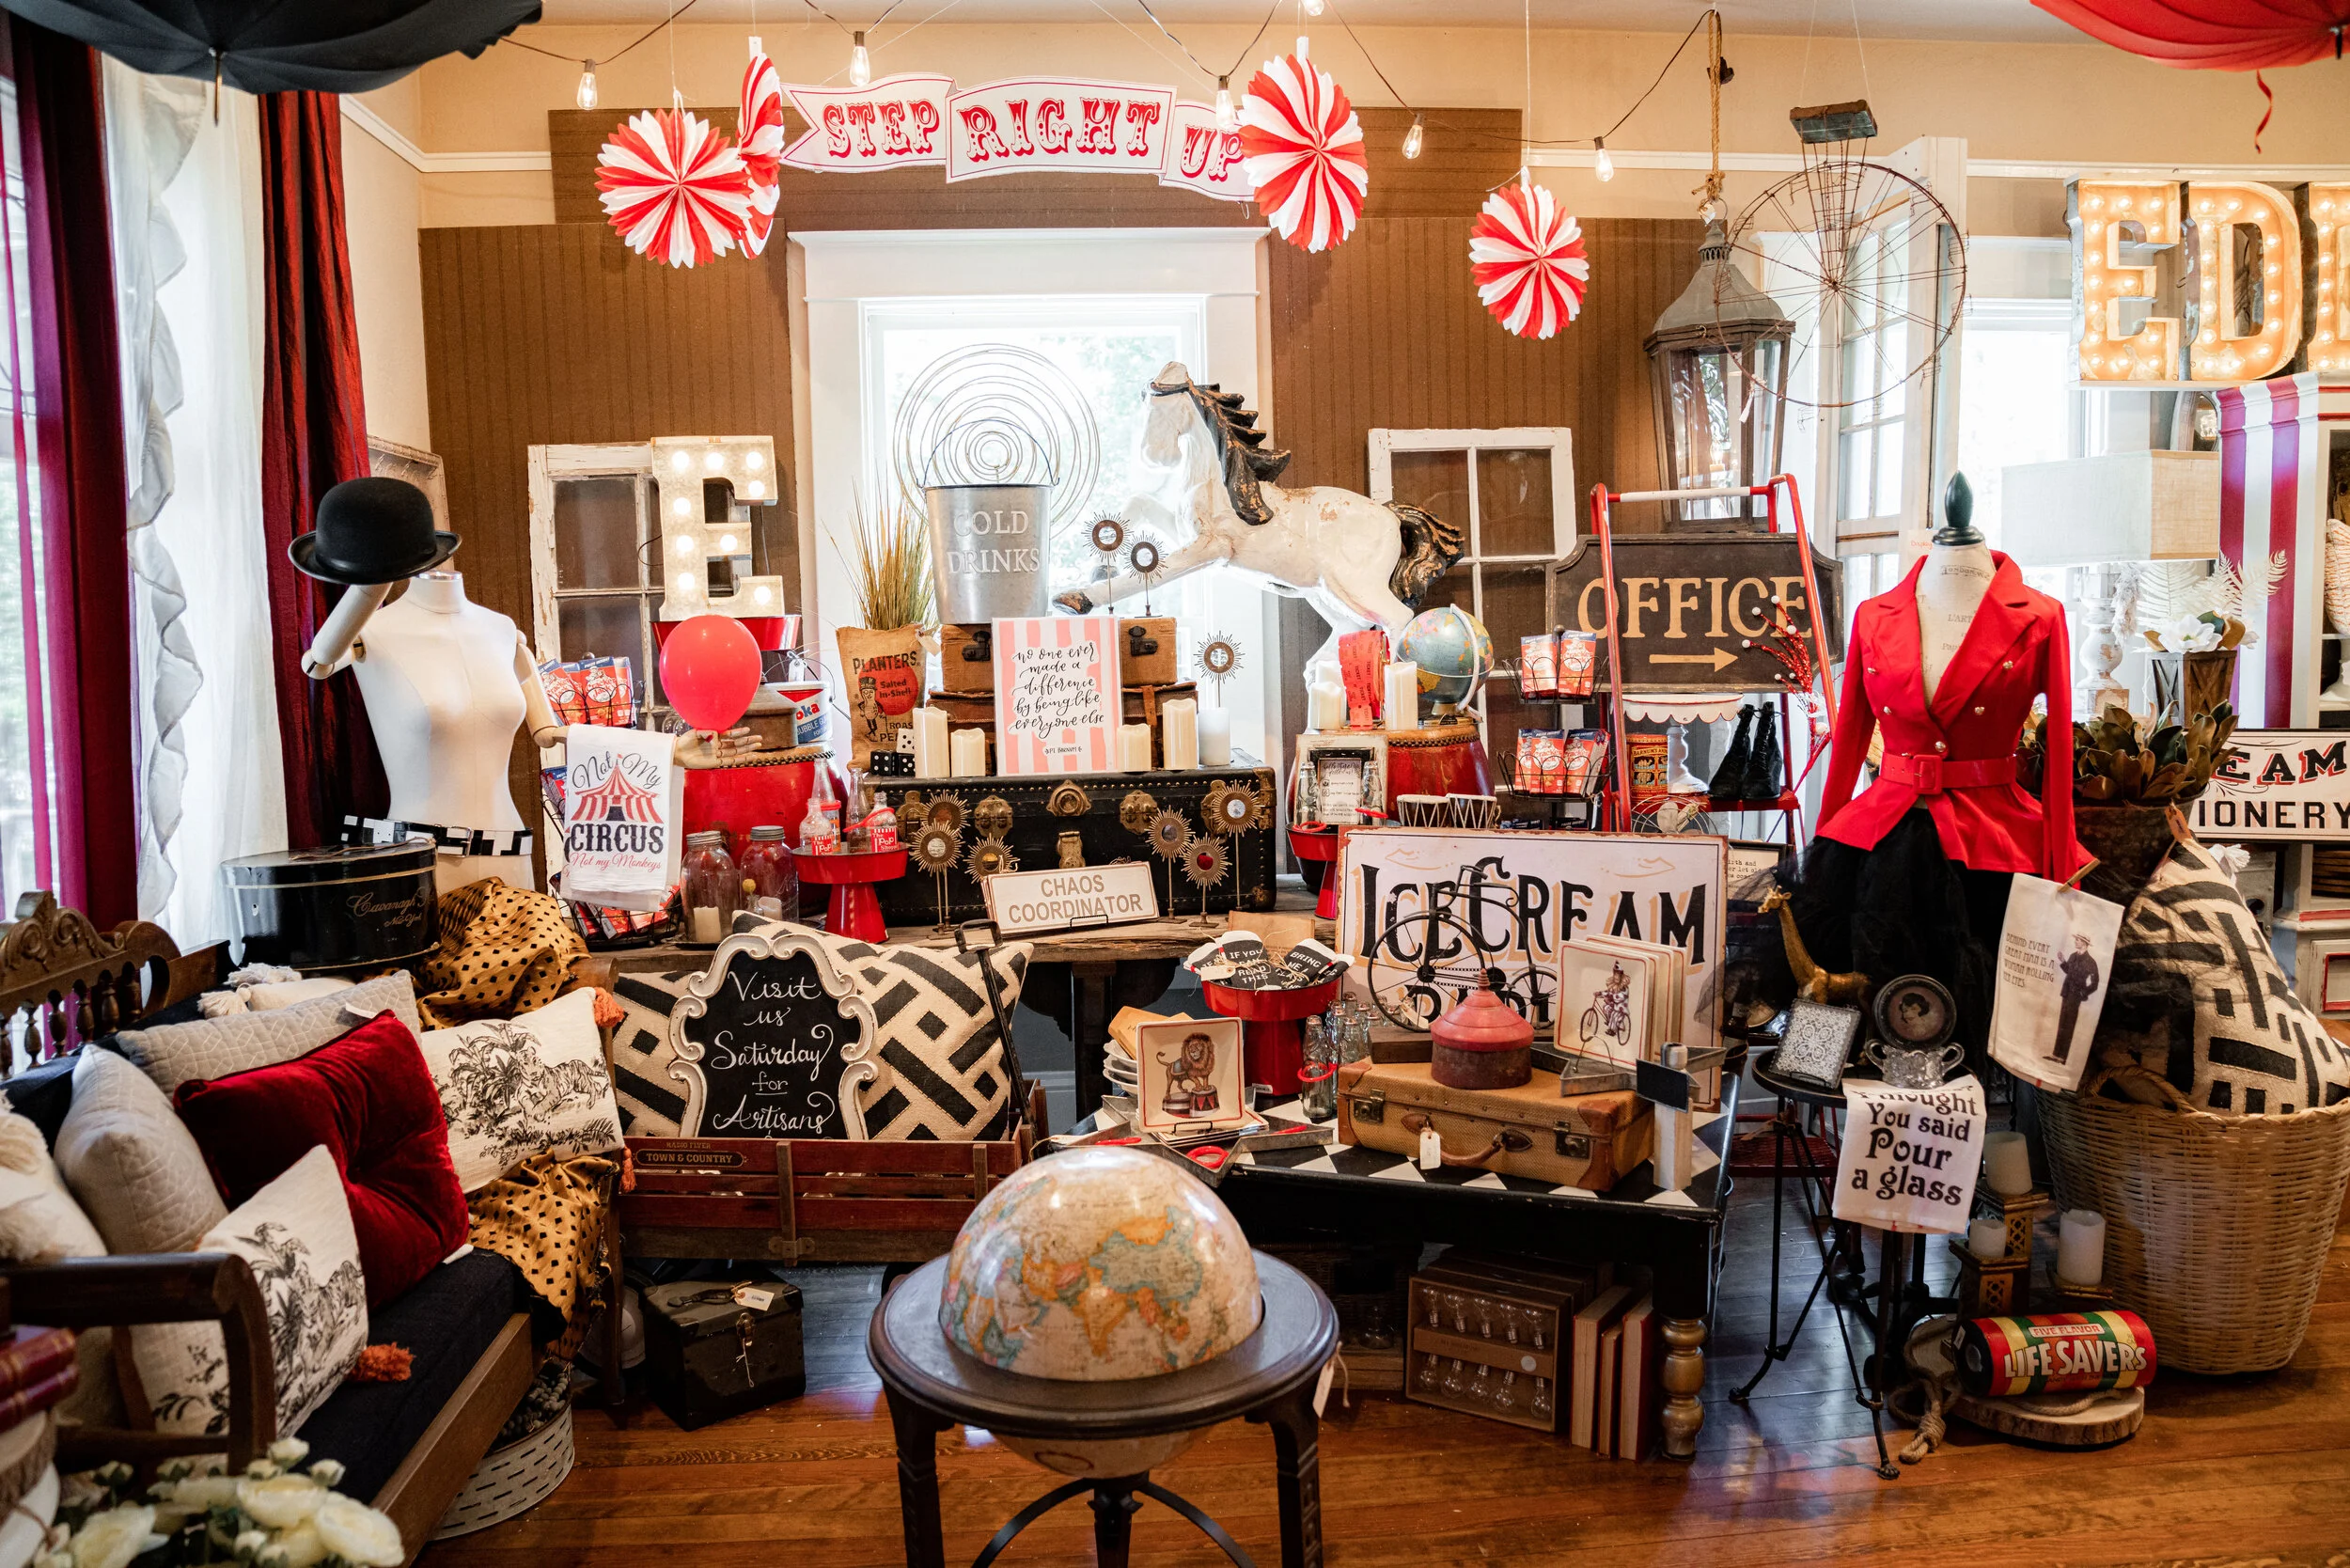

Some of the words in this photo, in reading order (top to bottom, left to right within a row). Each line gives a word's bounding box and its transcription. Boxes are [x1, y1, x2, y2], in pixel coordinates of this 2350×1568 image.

[822, 98, 940, 157] STEP
[956, 97, 1161, 162] RIGHT
[1182, 124, 1243, 181] UP
[651, 436, 785, 622] E
[954, 510, 1028, 536] COLD
[947, 548, 1040, 573] DRINKS
[1577, 575, 1812, 639] OFFICE
[853, 651, 917, 674] PLANTERS
[1039, 648, 1062, 660] one
[1068, 641, 1094, 662] ever
[1019, 660, 1066, 678] made
[1072, 661, 1081, 669] a
[880, 679, 906, 688] Salted
[880, 688, 911, 698] In-Shell
[1011, 673, 1094, 696] difference
[795, 703, 820, 720] oka
[1014, 698, 1030, 717] by
[1035, 696, 1071, 716] being
[1071, 689, 1101, 708] like
[1081, 709, 1104, 724] else
[572, 751, 614, 789] Not
[621, 753, 662, 790] My
[2199, 800, 2350, 829] IONERY
[571, 823, 664, 855] CIRCUS
[570, 853, 594, 868] Not
[595, 856, 611, 870] my
[612, 854, 662, 872] Monkeys
[1041, 874, 1104, 898] CHAOS
[1009, 894, 1143, 923] COORDINATOR
[1360, 863, 1461, 963] ICE
[1242, 949, 1263, 958] YOU
[2028, 940, 2050, 953] EVERY
[1290, 951, 1322, 968] BRING
[2023, 952, 2039, 965] MAN
[2040, 957, 2047, 966] IS
[2048, 959, 2055, 969] A
[1242, 974, 1268, 984] THIS
[2026, 966, 2054, 982] ROLLING
[728, 971, 822, 1001] Visit
[743, 1007, 791, 1027] us
[711, 1024, 835, 1082] Saturday
[752, 1071, 789, 1091] for
[713, 1091, 836, 1135] Artisans
[1865, 1102, 1910, 1129] You
[1918, 1117, 1971, 1142] said
[646, 1152, 676, 1163] TOWN
[678, 1153, 685, 1162] &
[686, 1153, 733, 1164] COUNTRY
[1865, 1128, 1952, 1170] Pour
[1851, 1168, 1869, 1190] a
[1875, 1165, 1964, 1206] glass
[2033, 1326, 2056, 1336] FIVE
[2058, 1325, 2102, 1335] FLAVOR
[2003, 1342, 2053, 1378] LIFE
[2055, 1340, 2148, 1375] SAVERS
